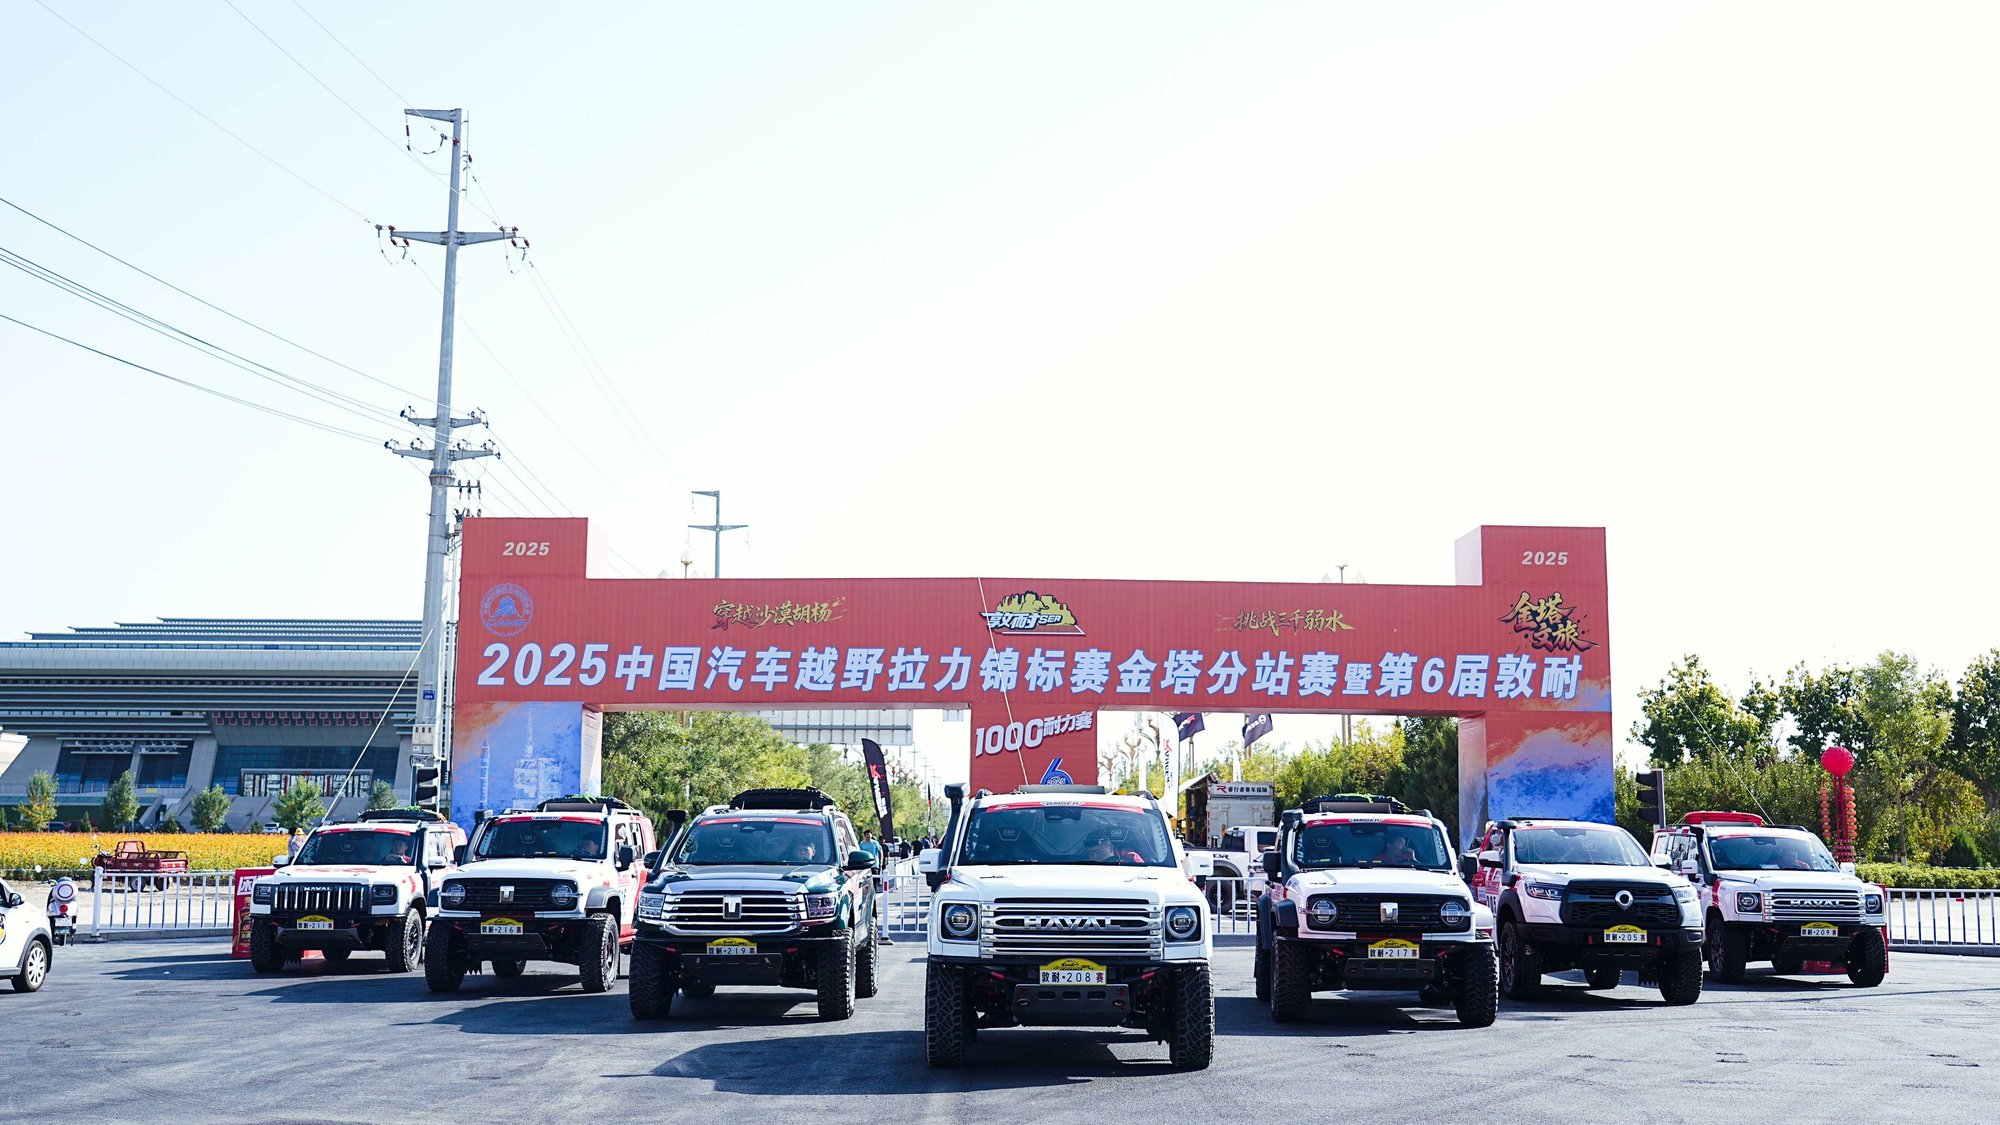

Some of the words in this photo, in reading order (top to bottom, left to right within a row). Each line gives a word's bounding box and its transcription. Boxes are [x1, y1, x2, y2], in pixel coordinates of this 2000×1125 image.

[502, 542, 551, 556] 2025
[1521, 551, 1568, 566] 2025
[710, 600, 833, 631] 穿越沙漠胡杨
[1233, 608, 1356, 637] 挑战三千弱水
[1498, 591, 1577, 633] 金塔
[1532, 620, 1600, 652] 文旅
[1790, 898, 1845, 908] HAVAL
[1023, 916, 1121, 931] HAVAL
